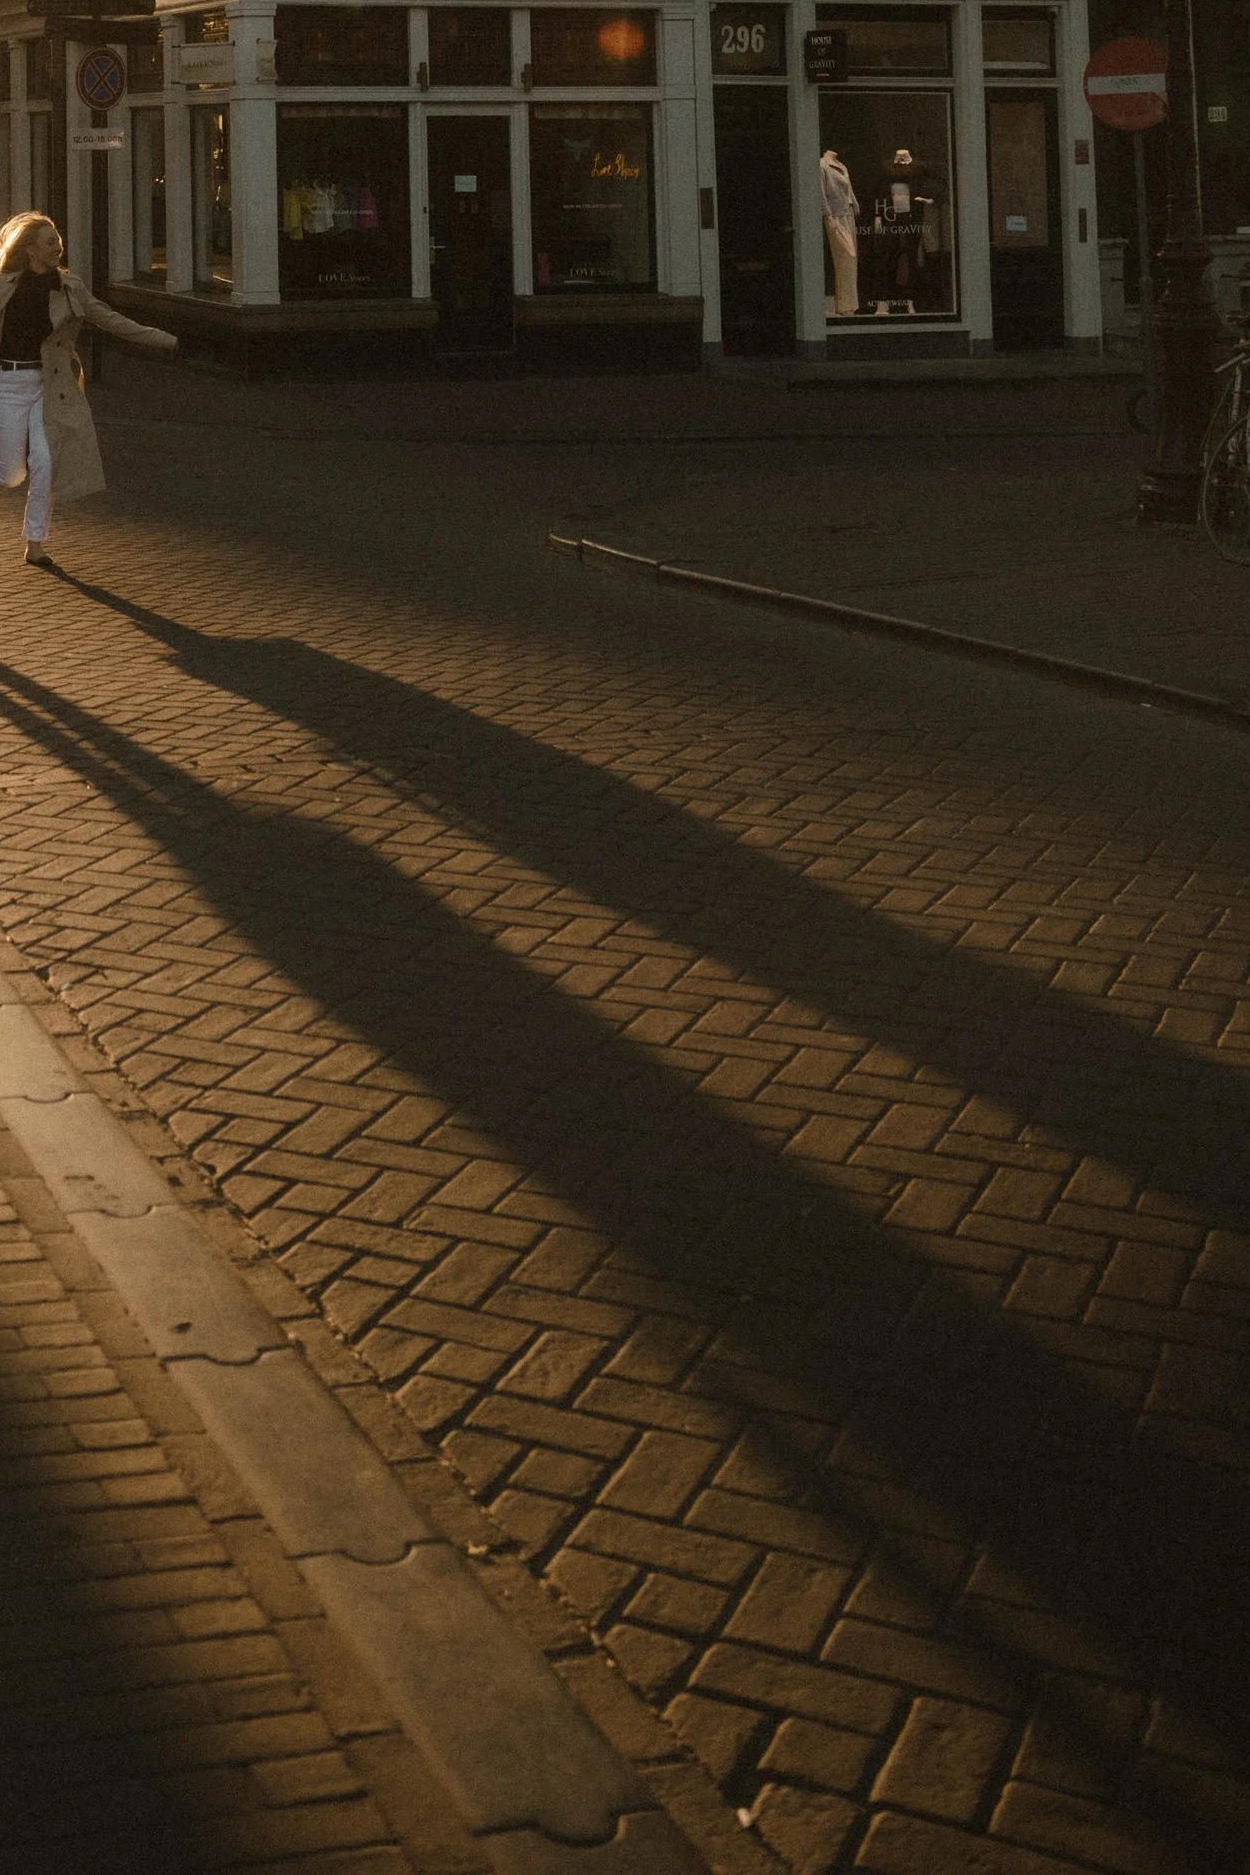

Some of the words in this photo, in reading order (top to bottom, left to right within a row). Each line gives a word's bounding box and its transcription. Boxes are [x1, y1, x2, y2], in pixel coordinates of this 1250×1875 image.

[721, 23, 766, 54] 296
[811, 36, 832, 45] HOUSE
[809, 59, 836, 69] GRAVITY
[890, 224, 932, 235] GRAVITY
